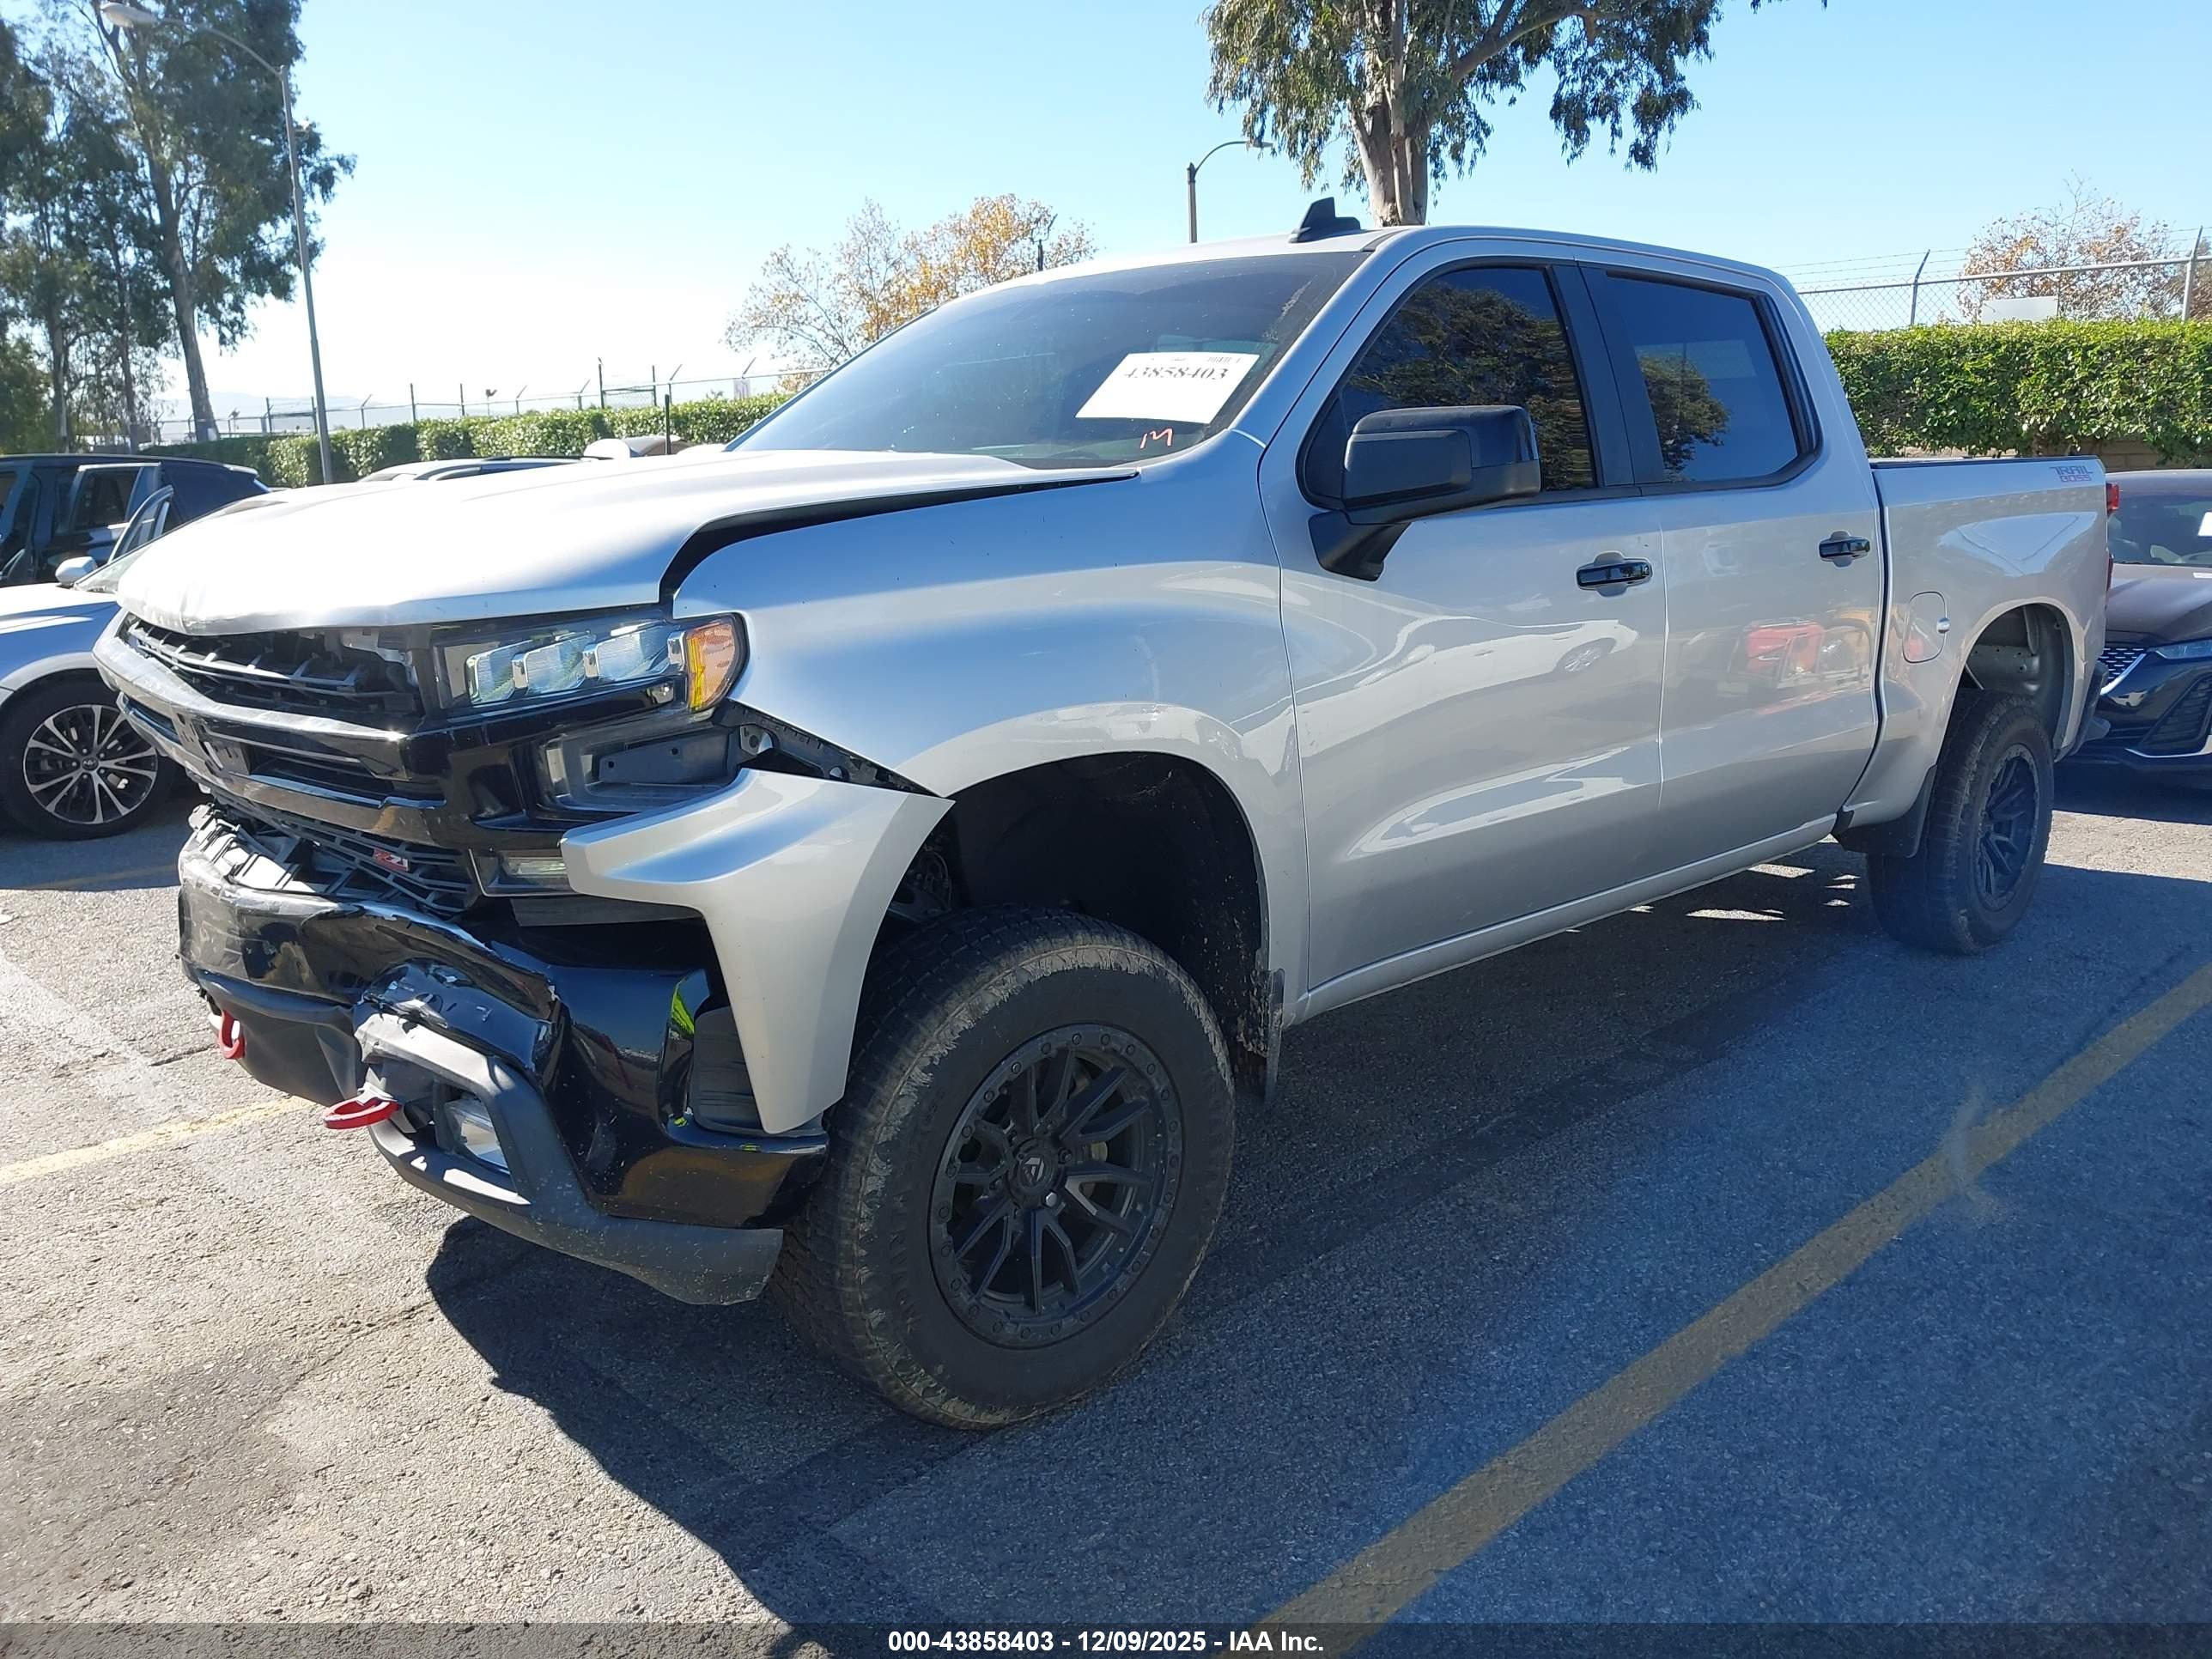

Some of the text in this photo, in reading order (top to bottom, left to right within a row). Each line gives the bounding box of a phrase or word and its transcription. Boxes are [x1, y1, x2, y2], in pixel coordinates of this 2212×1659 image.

[2049, 465, 2094, 476] TRAIL
[2060, 474, 2092, 483] BOSS
[374, 848, 409, 872] Z71
